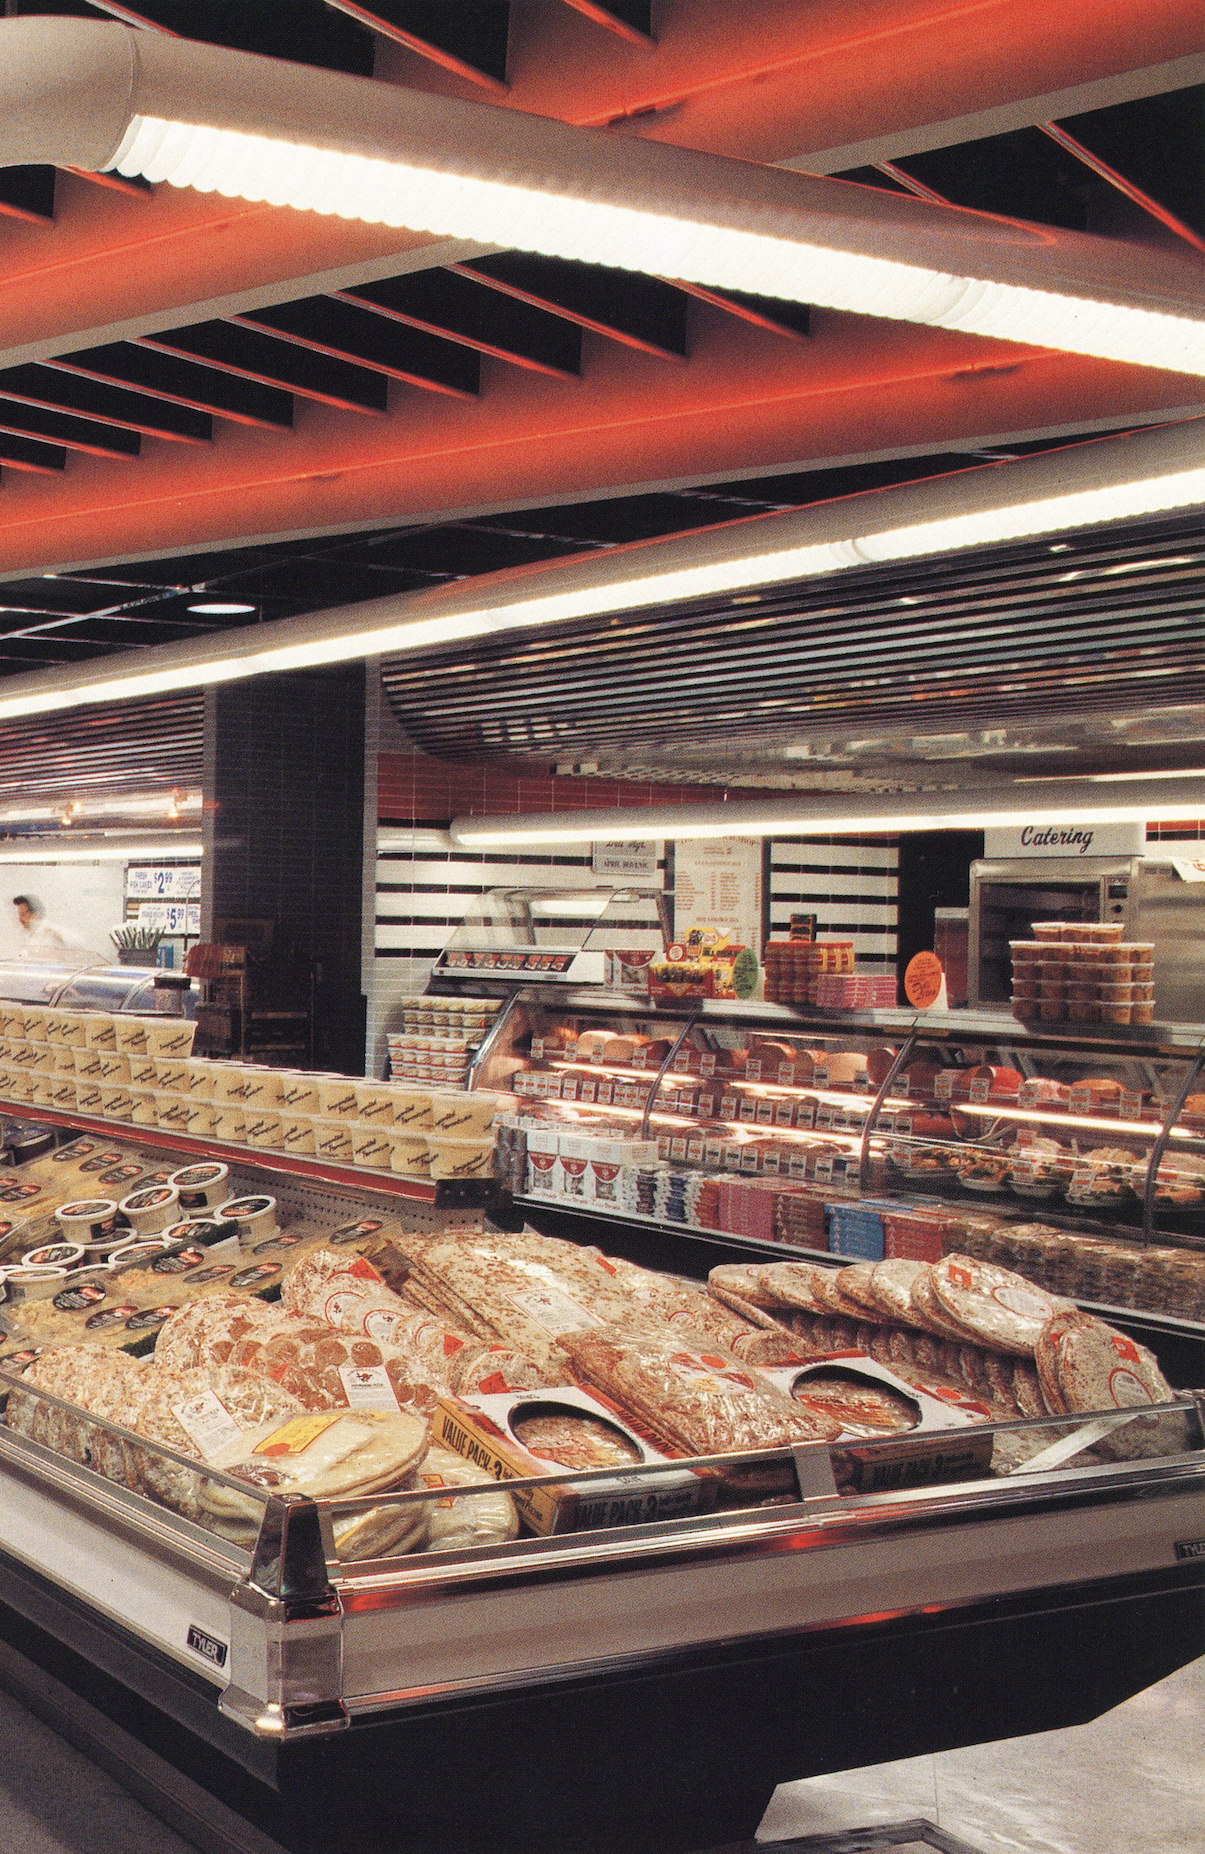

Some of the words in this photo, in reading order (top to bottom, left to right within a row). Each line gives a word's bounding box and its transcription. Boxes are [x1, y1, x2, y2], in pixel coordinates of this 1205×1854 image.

[1020, 825, 1094, 853] Catering
[441, 1415, 468, 1457] VALUE
[192, 1631, 219, 1661] TYLER
